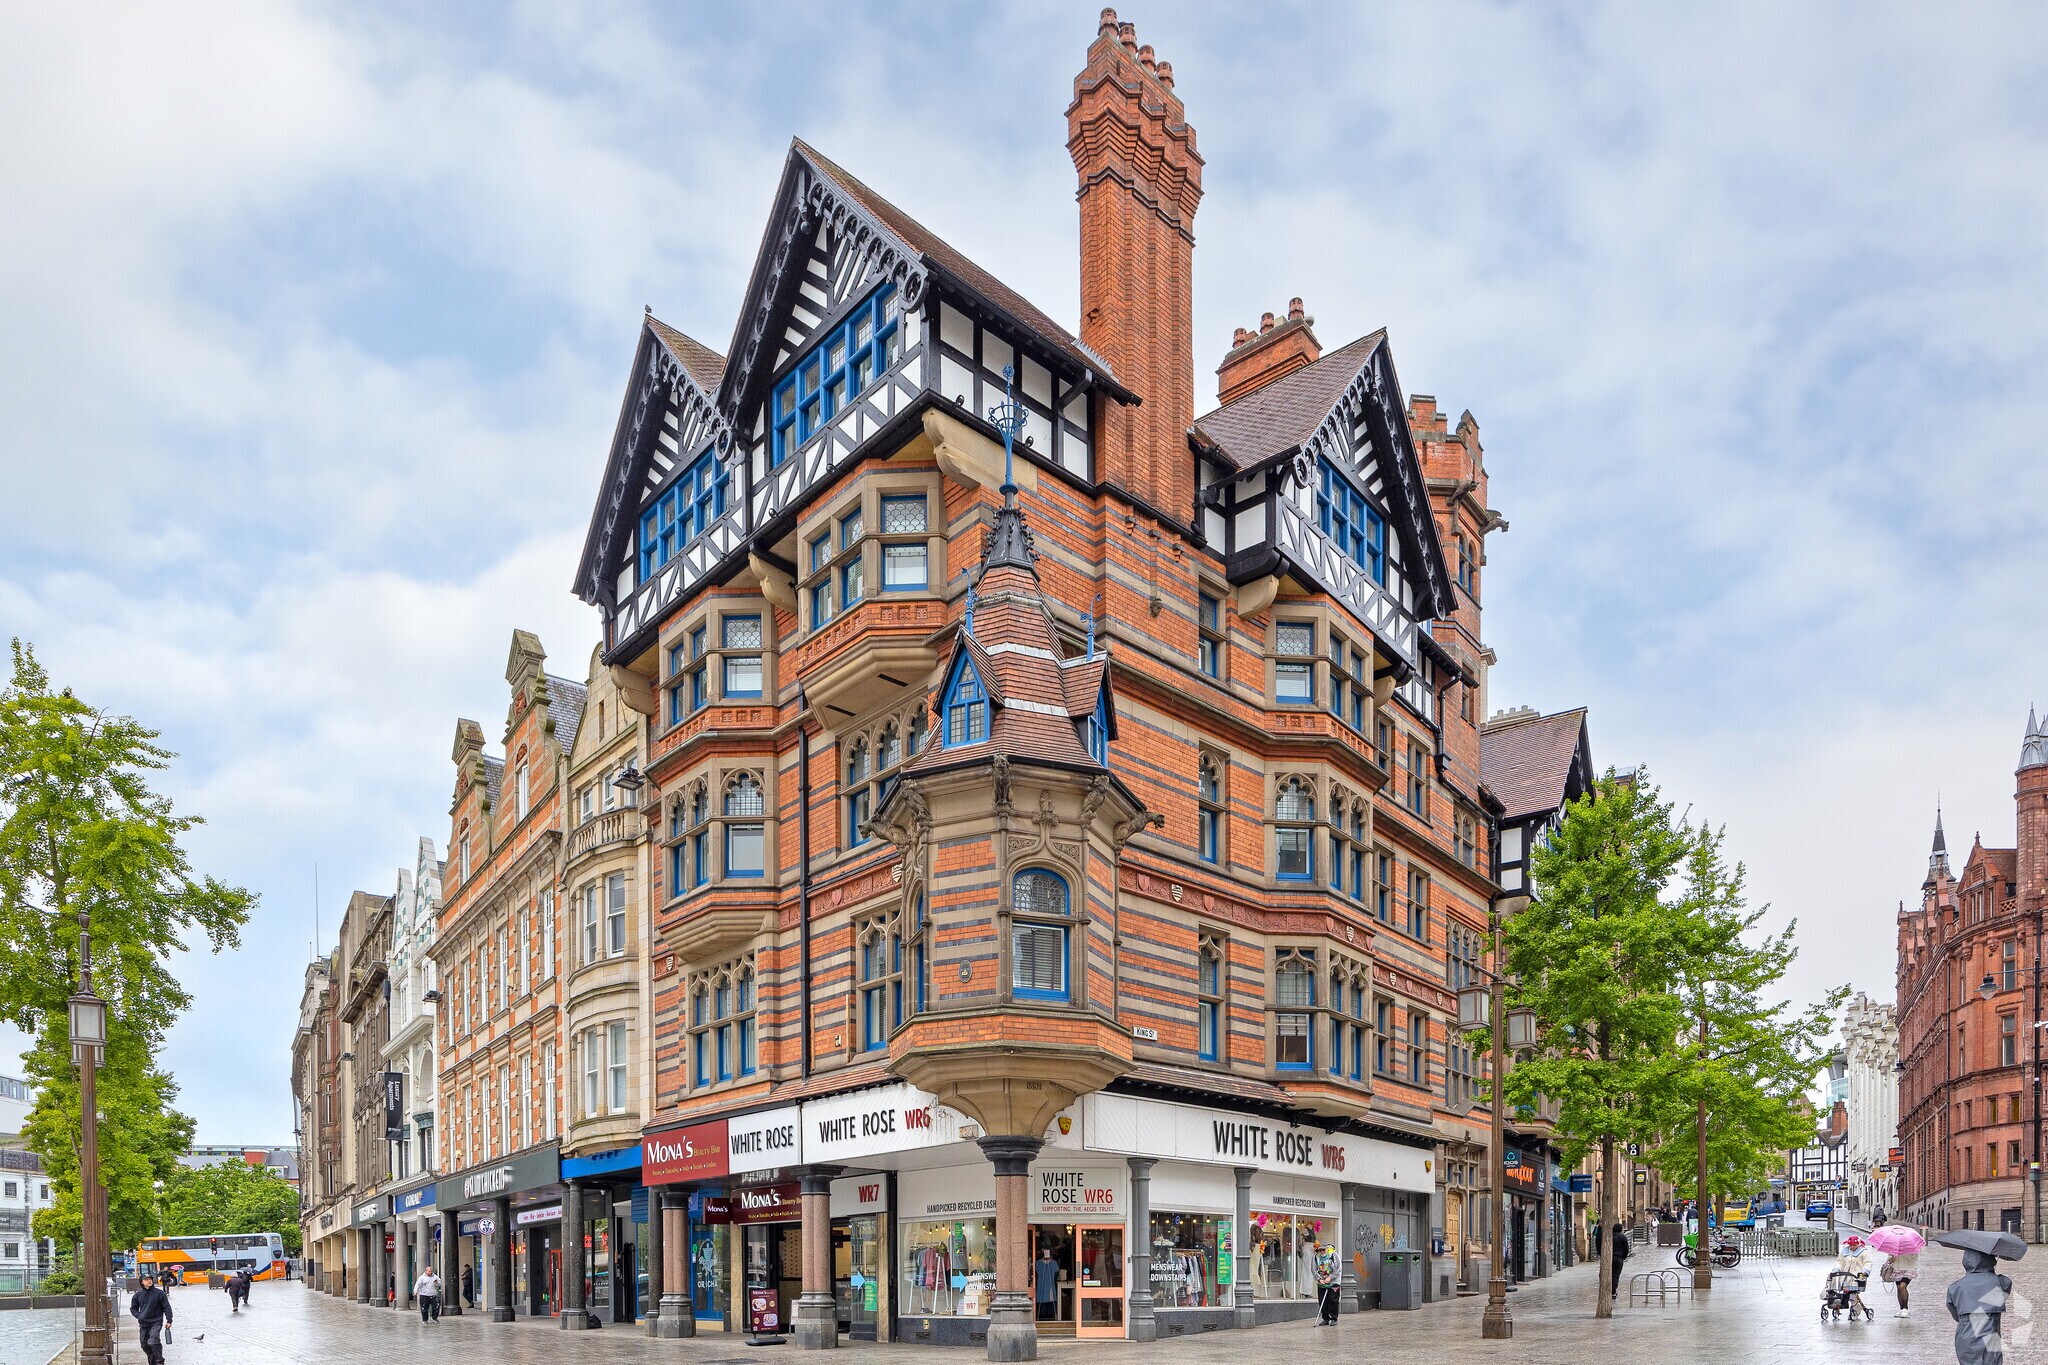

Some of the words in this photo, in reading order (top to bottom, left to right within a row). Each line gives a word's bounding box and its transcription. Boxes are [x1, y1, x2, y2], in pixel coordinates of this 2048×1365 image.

[1136, 1027, 1148, 1037] KING
[819, 1116, 856, 1143] WHITE
[862, 1109, 895, 1136] ROSE
[904, 1106, 931, 1129] WR6
[731, 1131, 762, 1155] WHITE
[766, 1125, 794, 1149] ROSE
[1213, 1120, 1268, 1159] WHITE
[1276, 1130, 1313, 1166] ROSE
[1321, 1143, 1345, 1172] WR6
[1042, 1172, 1084, 1187] WHITE
[405, 1192, 420, 1207] CORAL
[858, 1184, 879, 1203] WR7
[1042, 1188, 1077, 1203] ROSE
[1084, 1188, 1113, 1203] WR6
[926, 1203, 956, 1214] HANDPICKED
[957, 1200, 983, 1212] RECYCLED
[983, 1199, 996, 1209] FASH
[1150, 1263, 1183, 1271] MENSWEAR
[972, 1272, 997, 1280] MENSWE
[1150, 1273, 1187, 1282] DOWNSTAIRS
[968, 1282, 997, 1291] DOWNSTA
